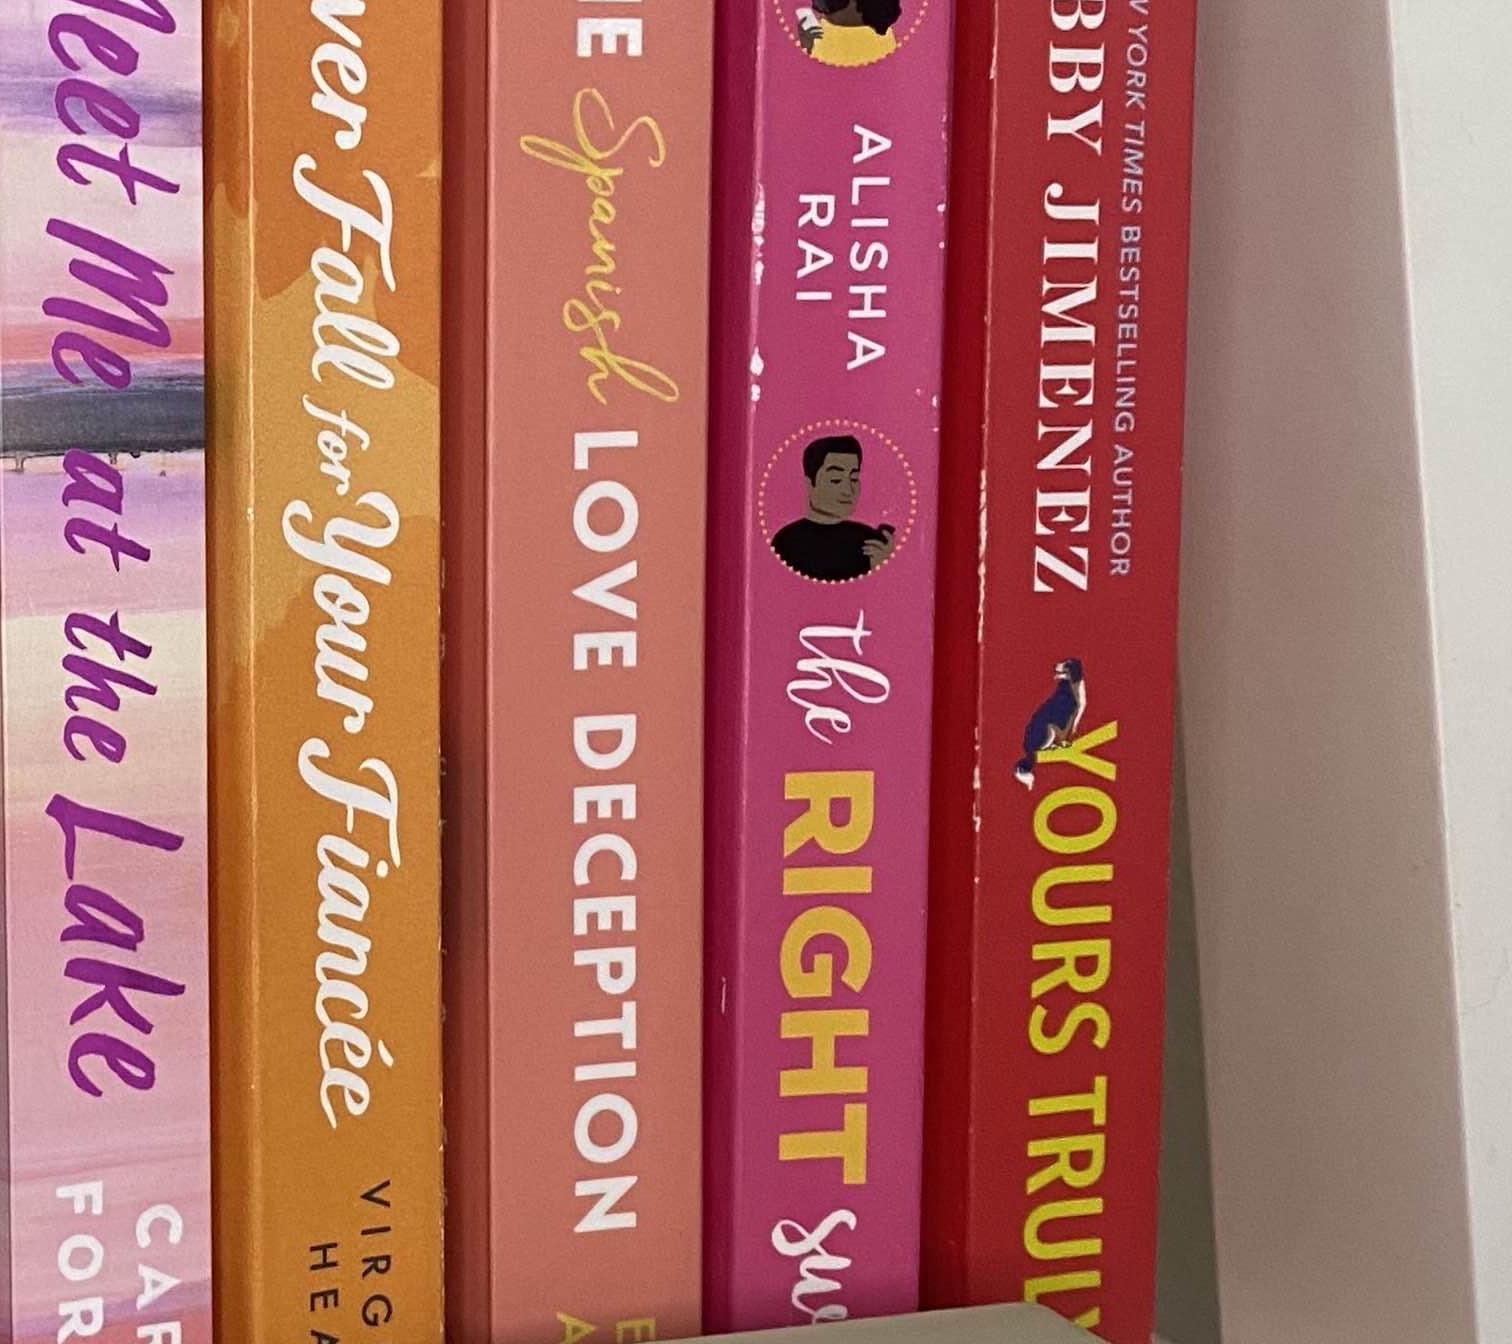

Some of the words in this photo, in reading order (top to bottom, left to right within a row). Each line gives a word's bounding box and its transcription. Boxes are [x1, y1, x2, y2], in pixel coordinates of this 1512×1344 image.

[1121, 120, 1146, 214] TIMES
[1125, 24, 1149, 111] YORK
[41, 217, 176, 390] Me
[293, 154, 401, 390] Fall
[519, 87, 680, 405] Spanish
[797, 192, 836, 303] RAI
[846, 124, 892, 372] ALISHA
[1113, 225, 1142, 433] BESTSELLING
[301, 393, 371, 495] for
[1034, 183, 1101, 593] JIMENEZ
[61, 448, 151, 572] at
[282, 490, 400, 735] Your
[571, 429, 641, 673] LOVE
[1108, 443, 1137, 576] AUTHOR
[61, 609, 158, 764] the
[784, 609, 891, 745] the
[44, 792, 186, 1098] Lake
[298, 737, 403, 1130] Fiancée
[572, 713, 639, 1234] DECEPTION
[779, 770, 875, 1185] RIGHT
[1027, 719, 1120, 1055] YOURS
